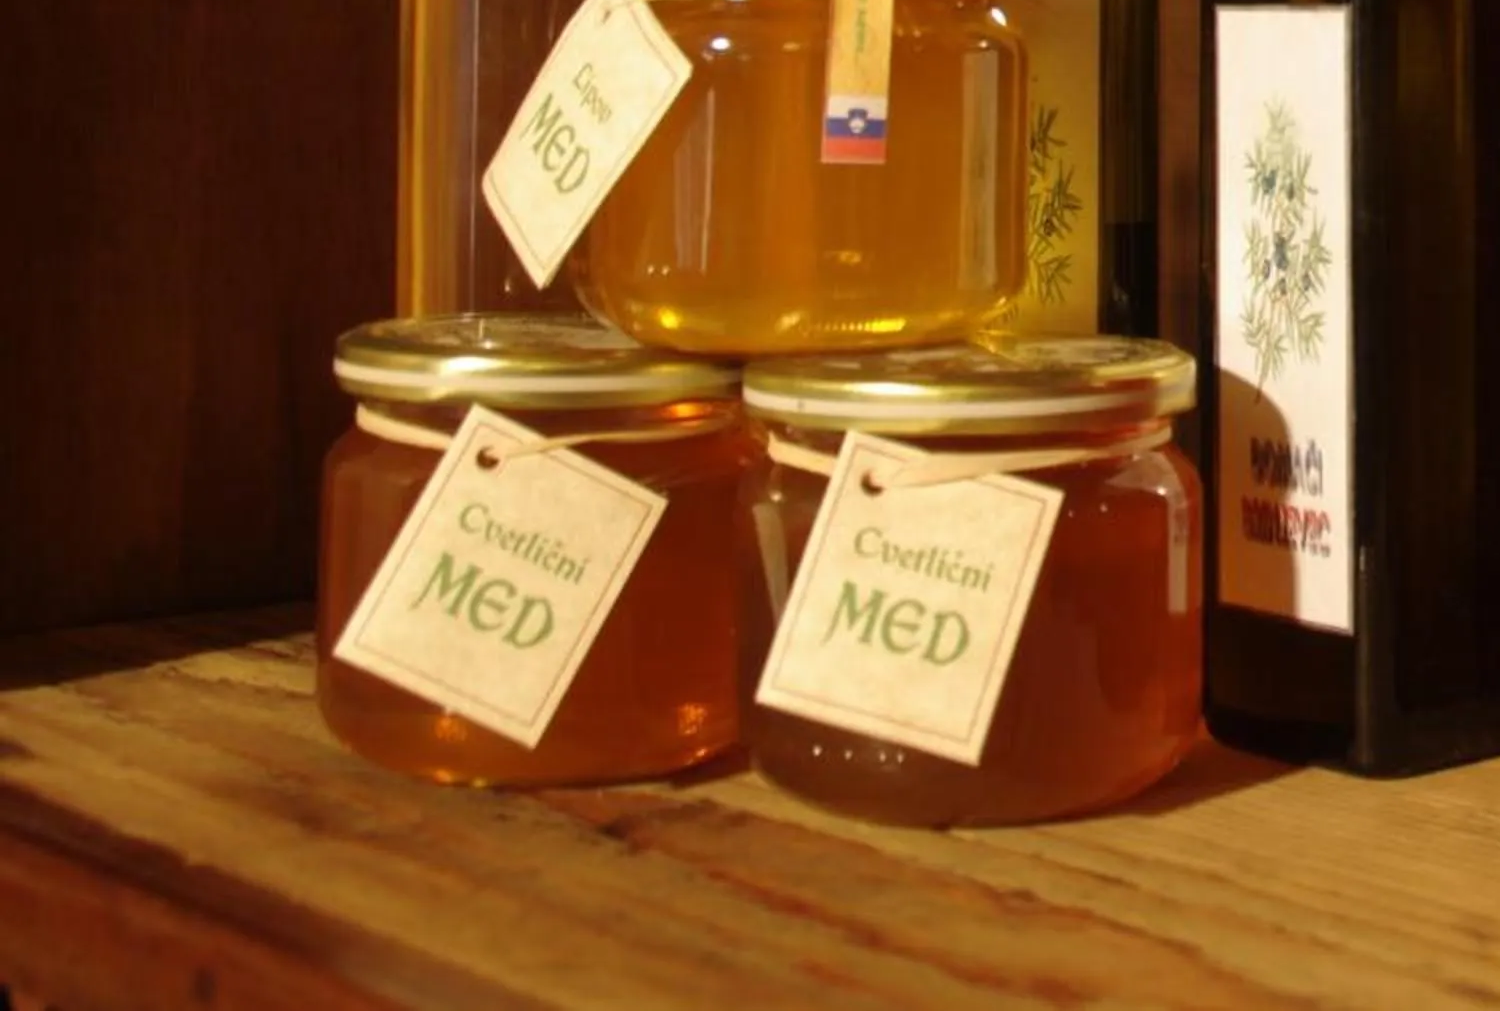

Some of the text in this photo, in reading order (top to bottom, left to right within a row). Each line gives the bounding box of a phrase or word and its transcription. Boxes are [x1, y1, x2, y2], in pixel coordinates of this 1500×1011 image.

[519, 92, 590, 195] MED
[409, 553, 555, 651] MED
[821, 580, 971, 668] MED
